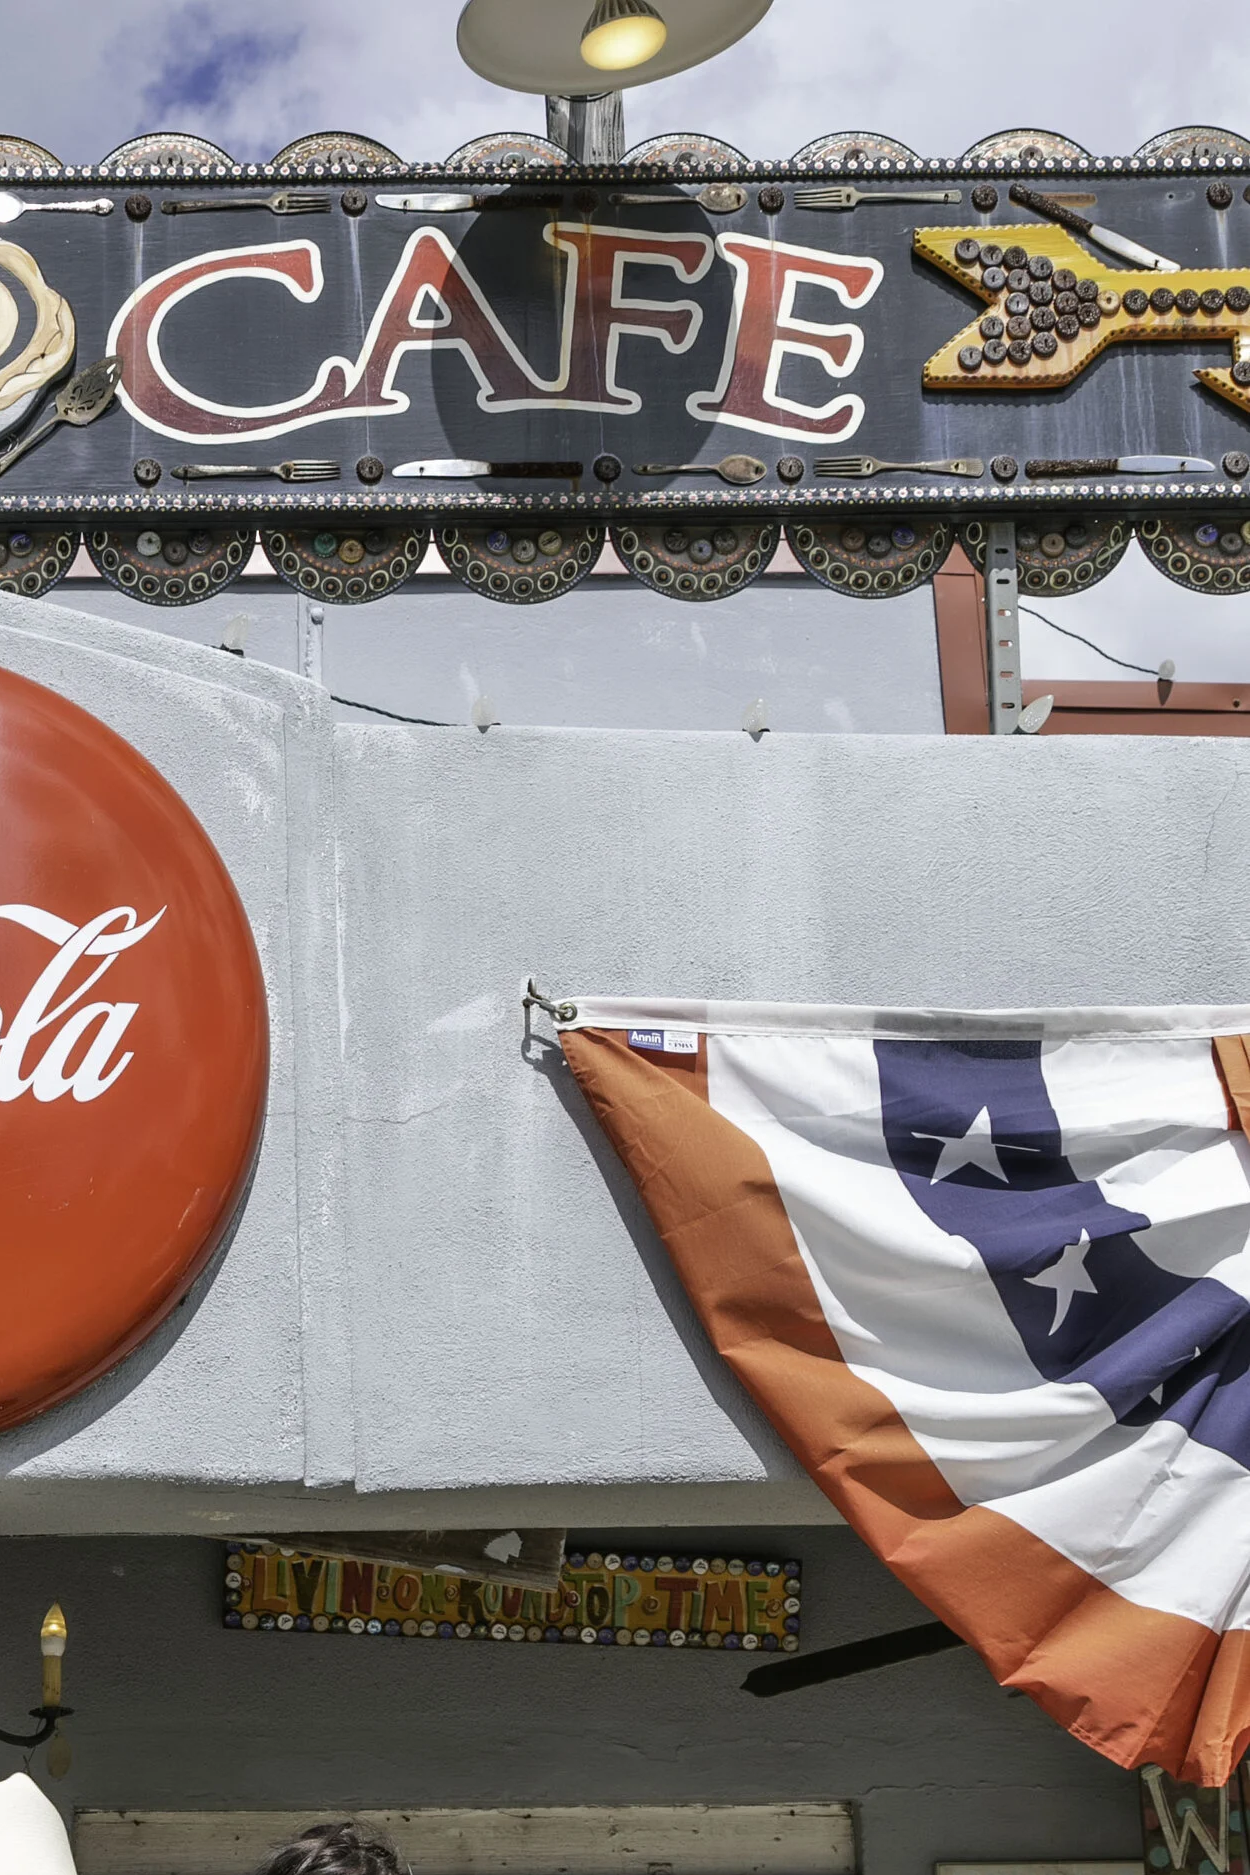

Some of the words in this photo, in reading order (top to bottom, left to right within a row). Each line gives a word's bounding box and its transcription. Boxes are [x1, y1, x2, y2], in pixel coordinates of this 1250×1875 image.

[107, 222, 885, 445] CAFE
[631, 1031, 662, 1044] Annin
[394, 1572, 446, 1615] ON
[563, 1572, 641, 1627] TOP
[655, 1575, 770, 1634] TIME
